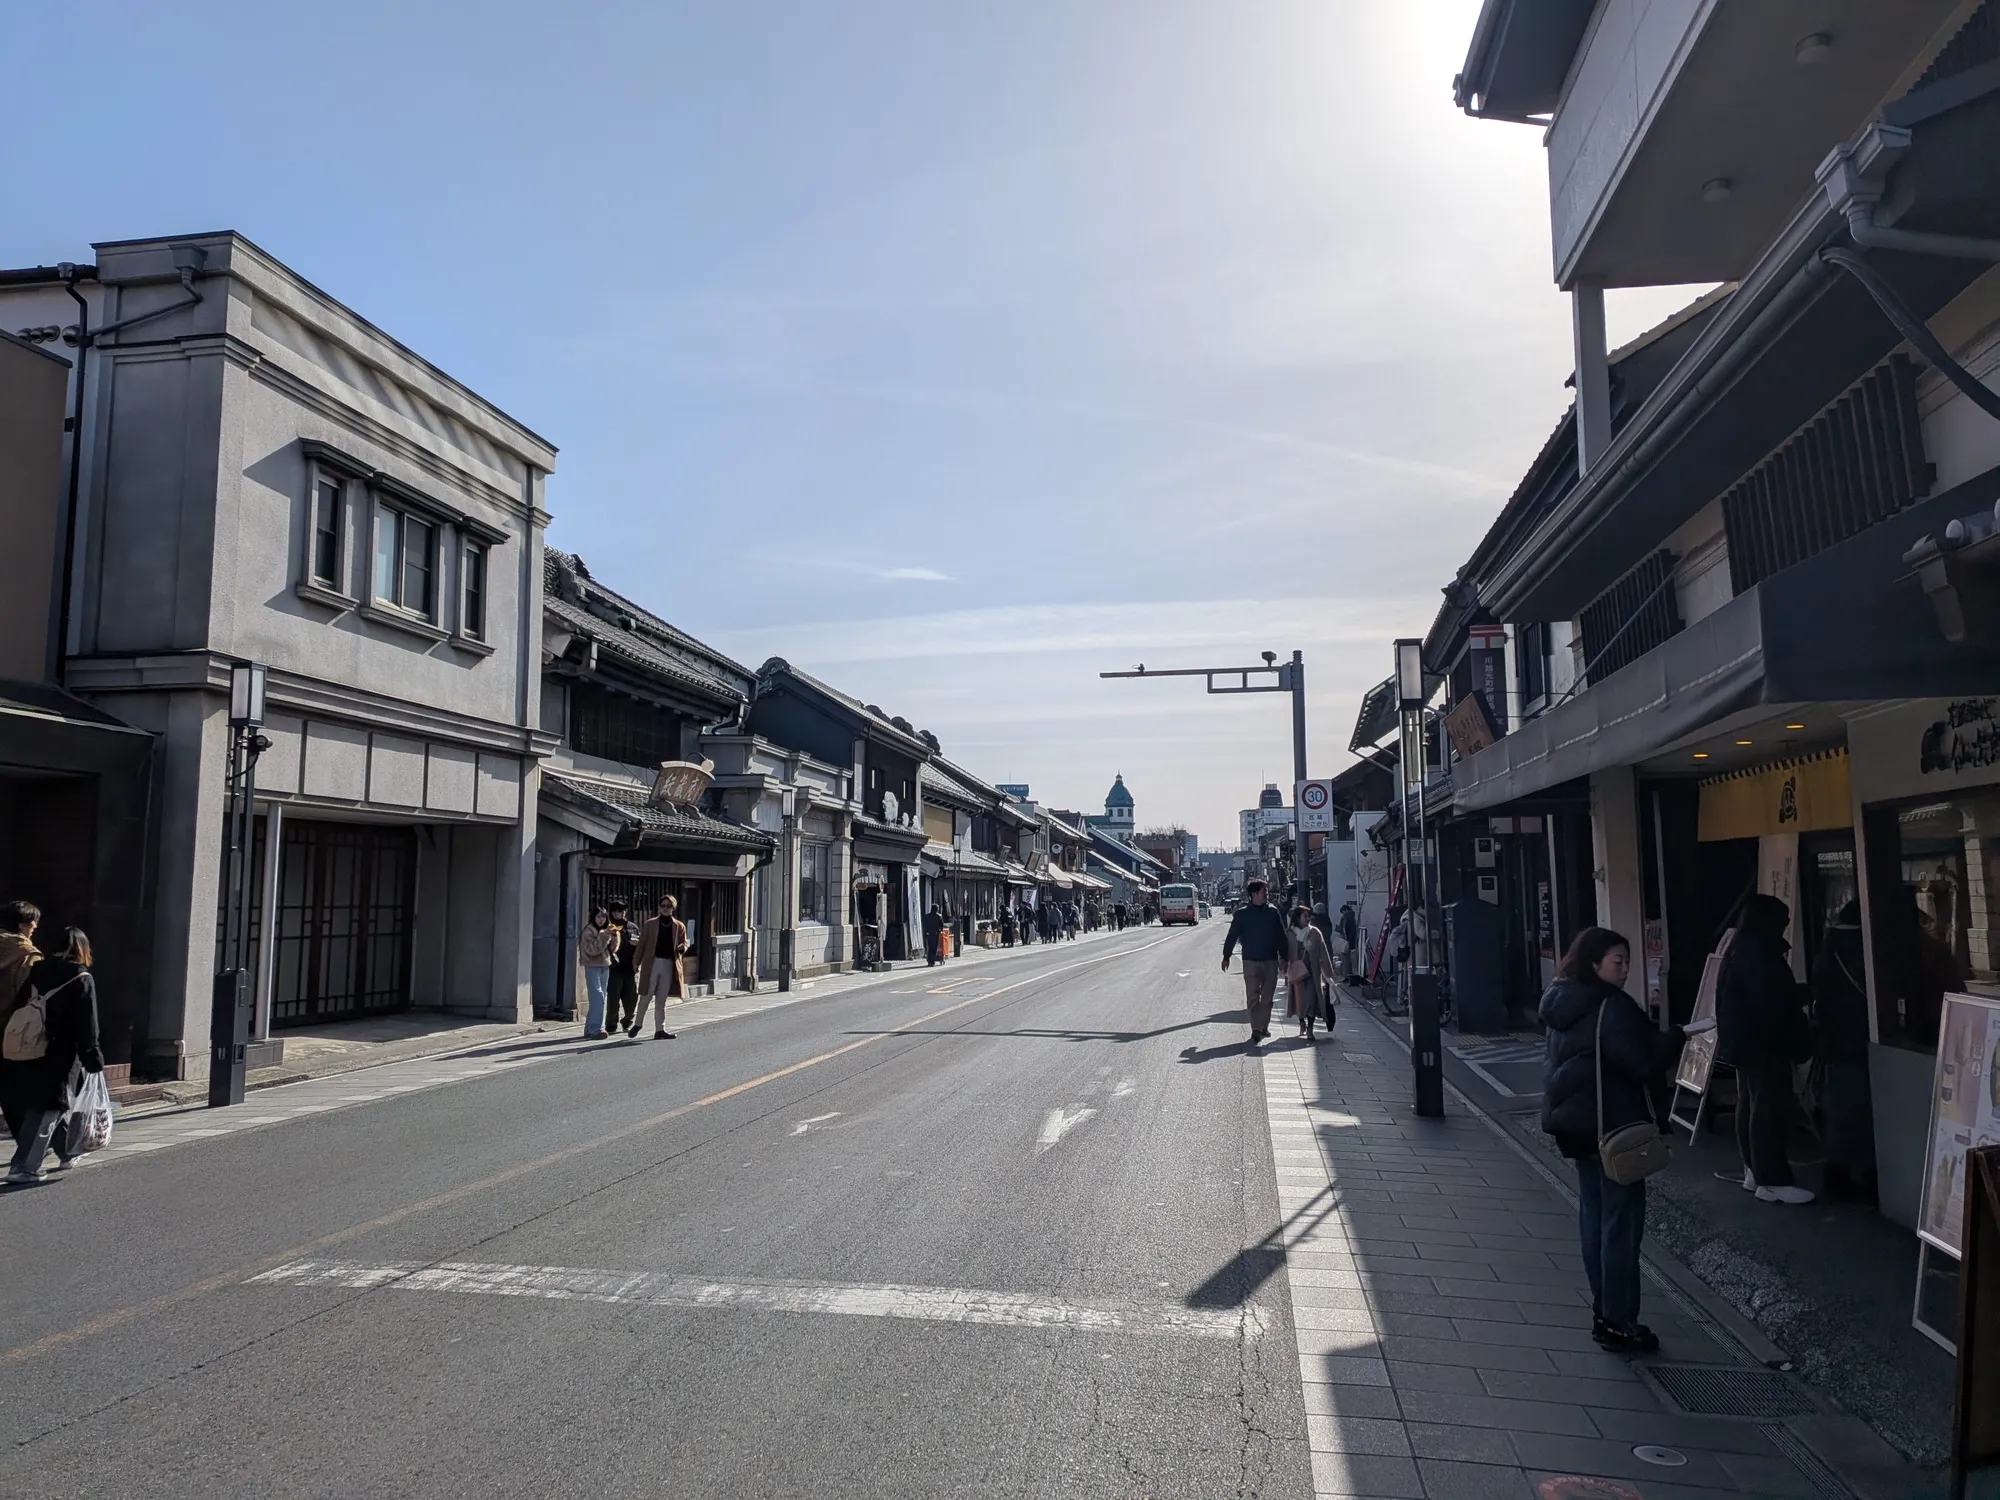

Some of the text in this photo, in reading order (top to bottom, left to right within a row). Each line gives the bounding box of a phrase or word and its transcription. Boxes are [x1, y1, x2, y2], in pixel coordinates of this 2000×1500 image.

[1307, 790, 1323, 803] 30
[1304, 821, 1329, 829] ここから
